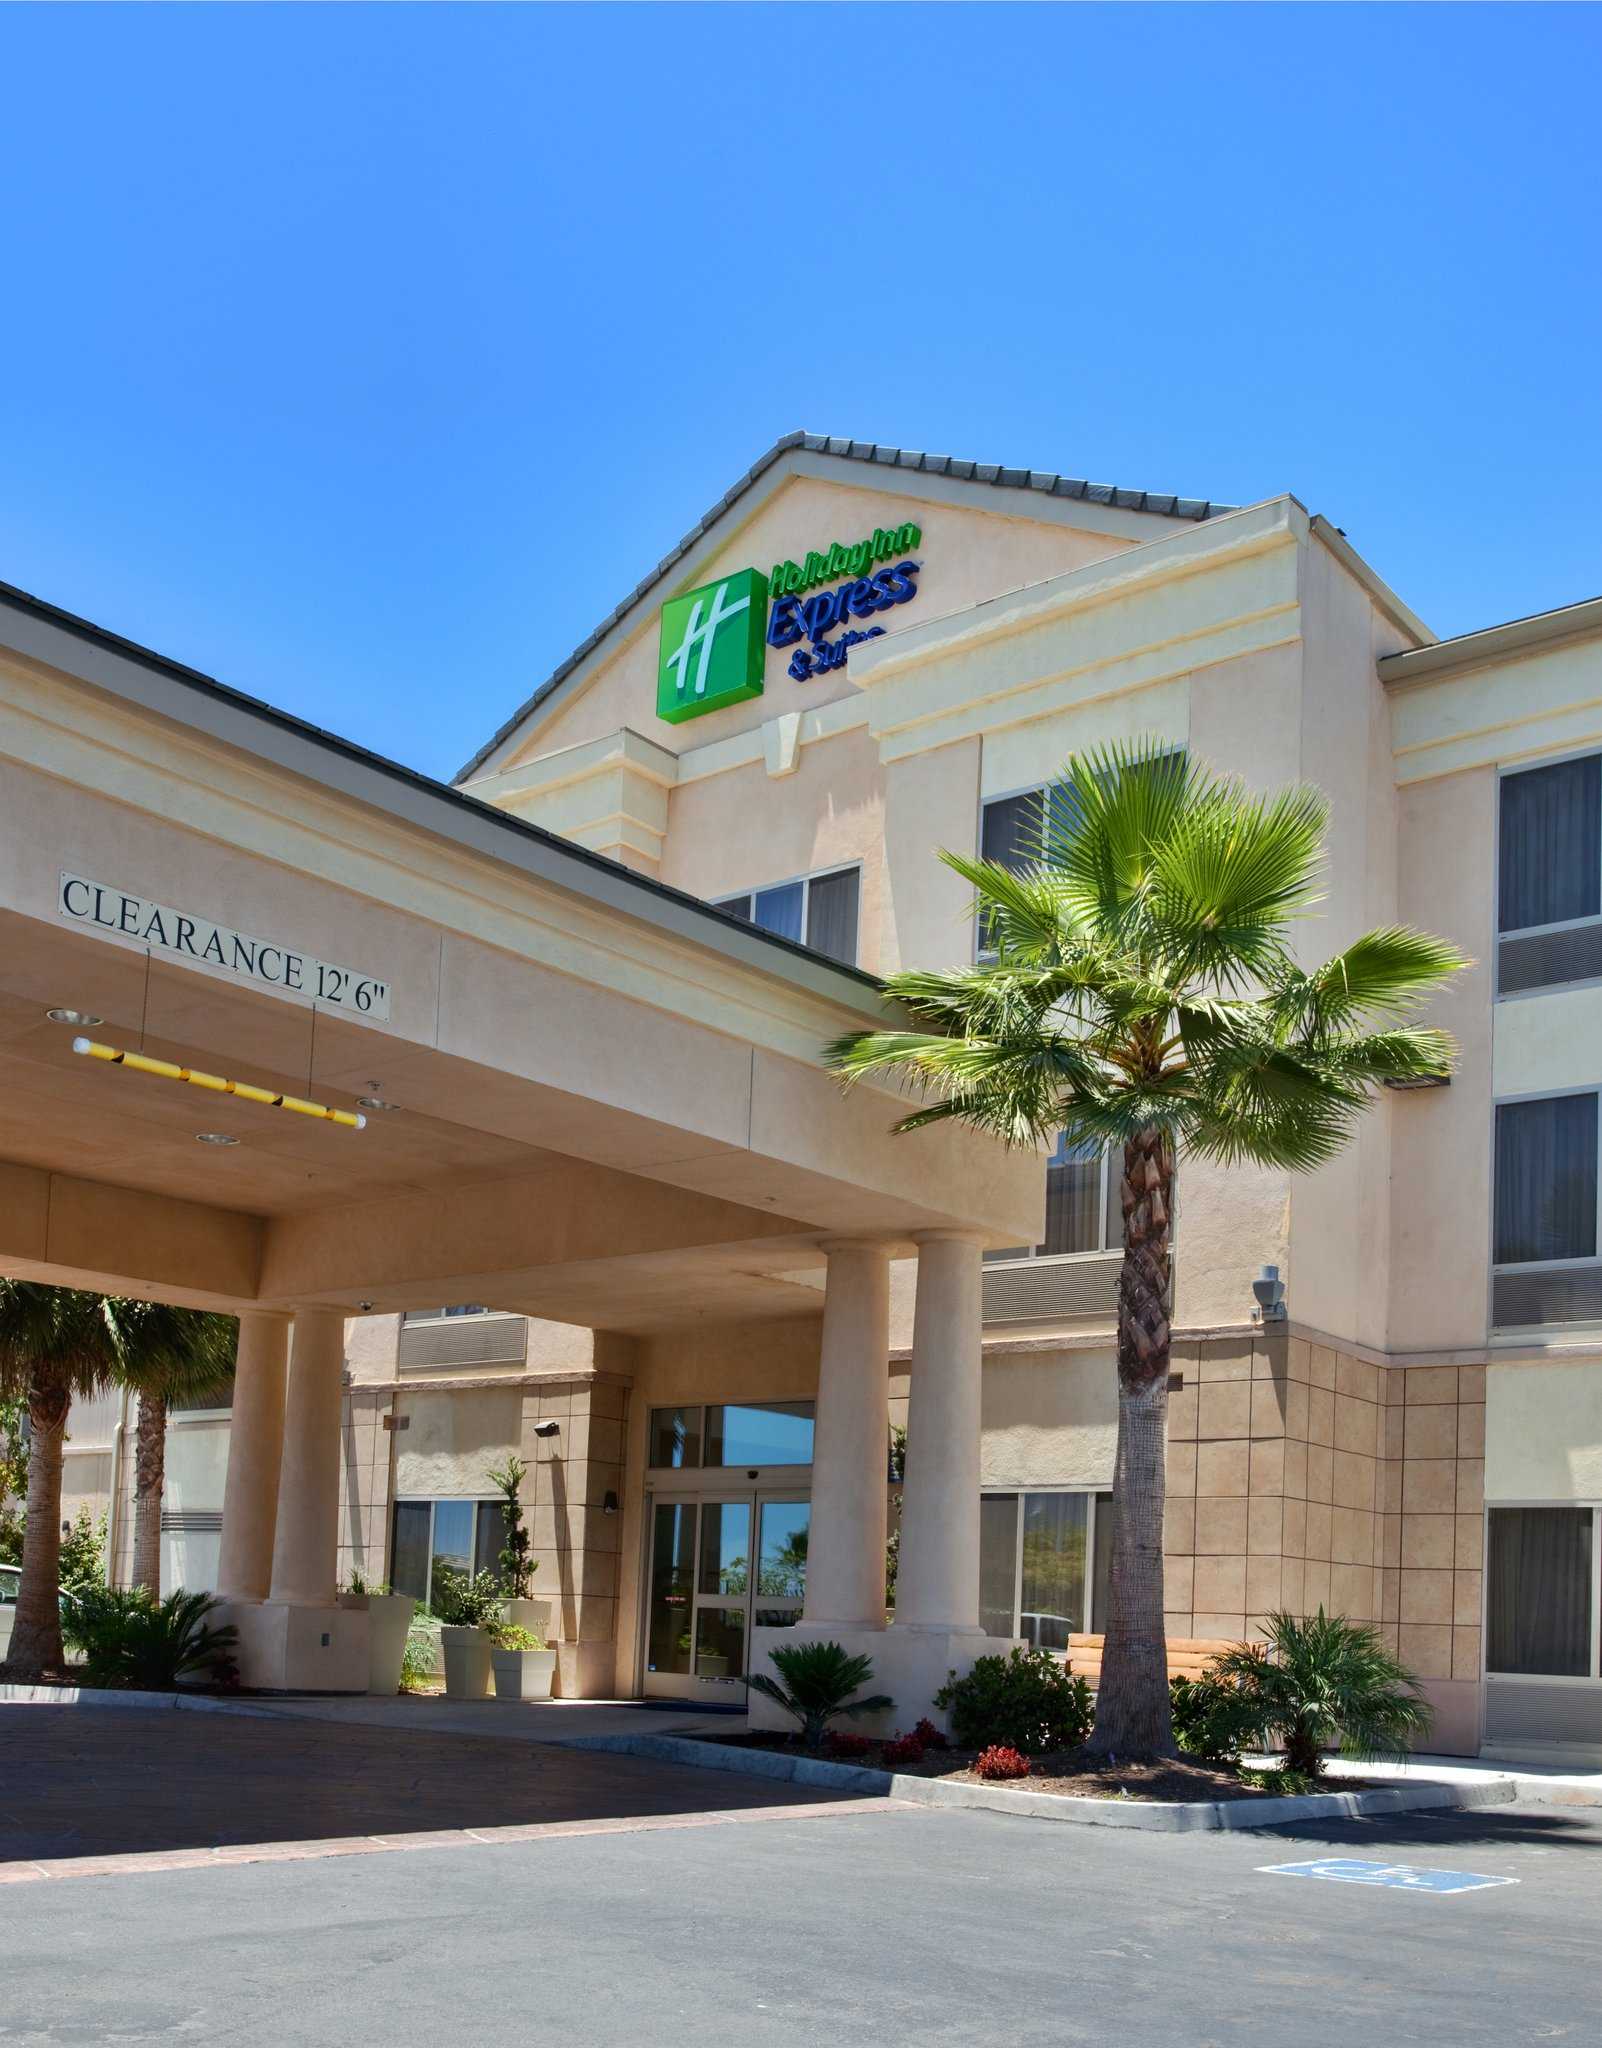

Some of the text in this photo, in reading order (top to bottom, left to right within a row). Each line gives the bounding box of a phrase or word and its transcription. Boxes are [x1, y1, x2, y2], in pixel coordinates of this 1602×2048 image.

[769, 522, 921, 600] Holiday Inn
[767, 561, 919, 649] Express
[788, 649, 812, 682] &
[63, 880, 303, 989] CLEARANCE
